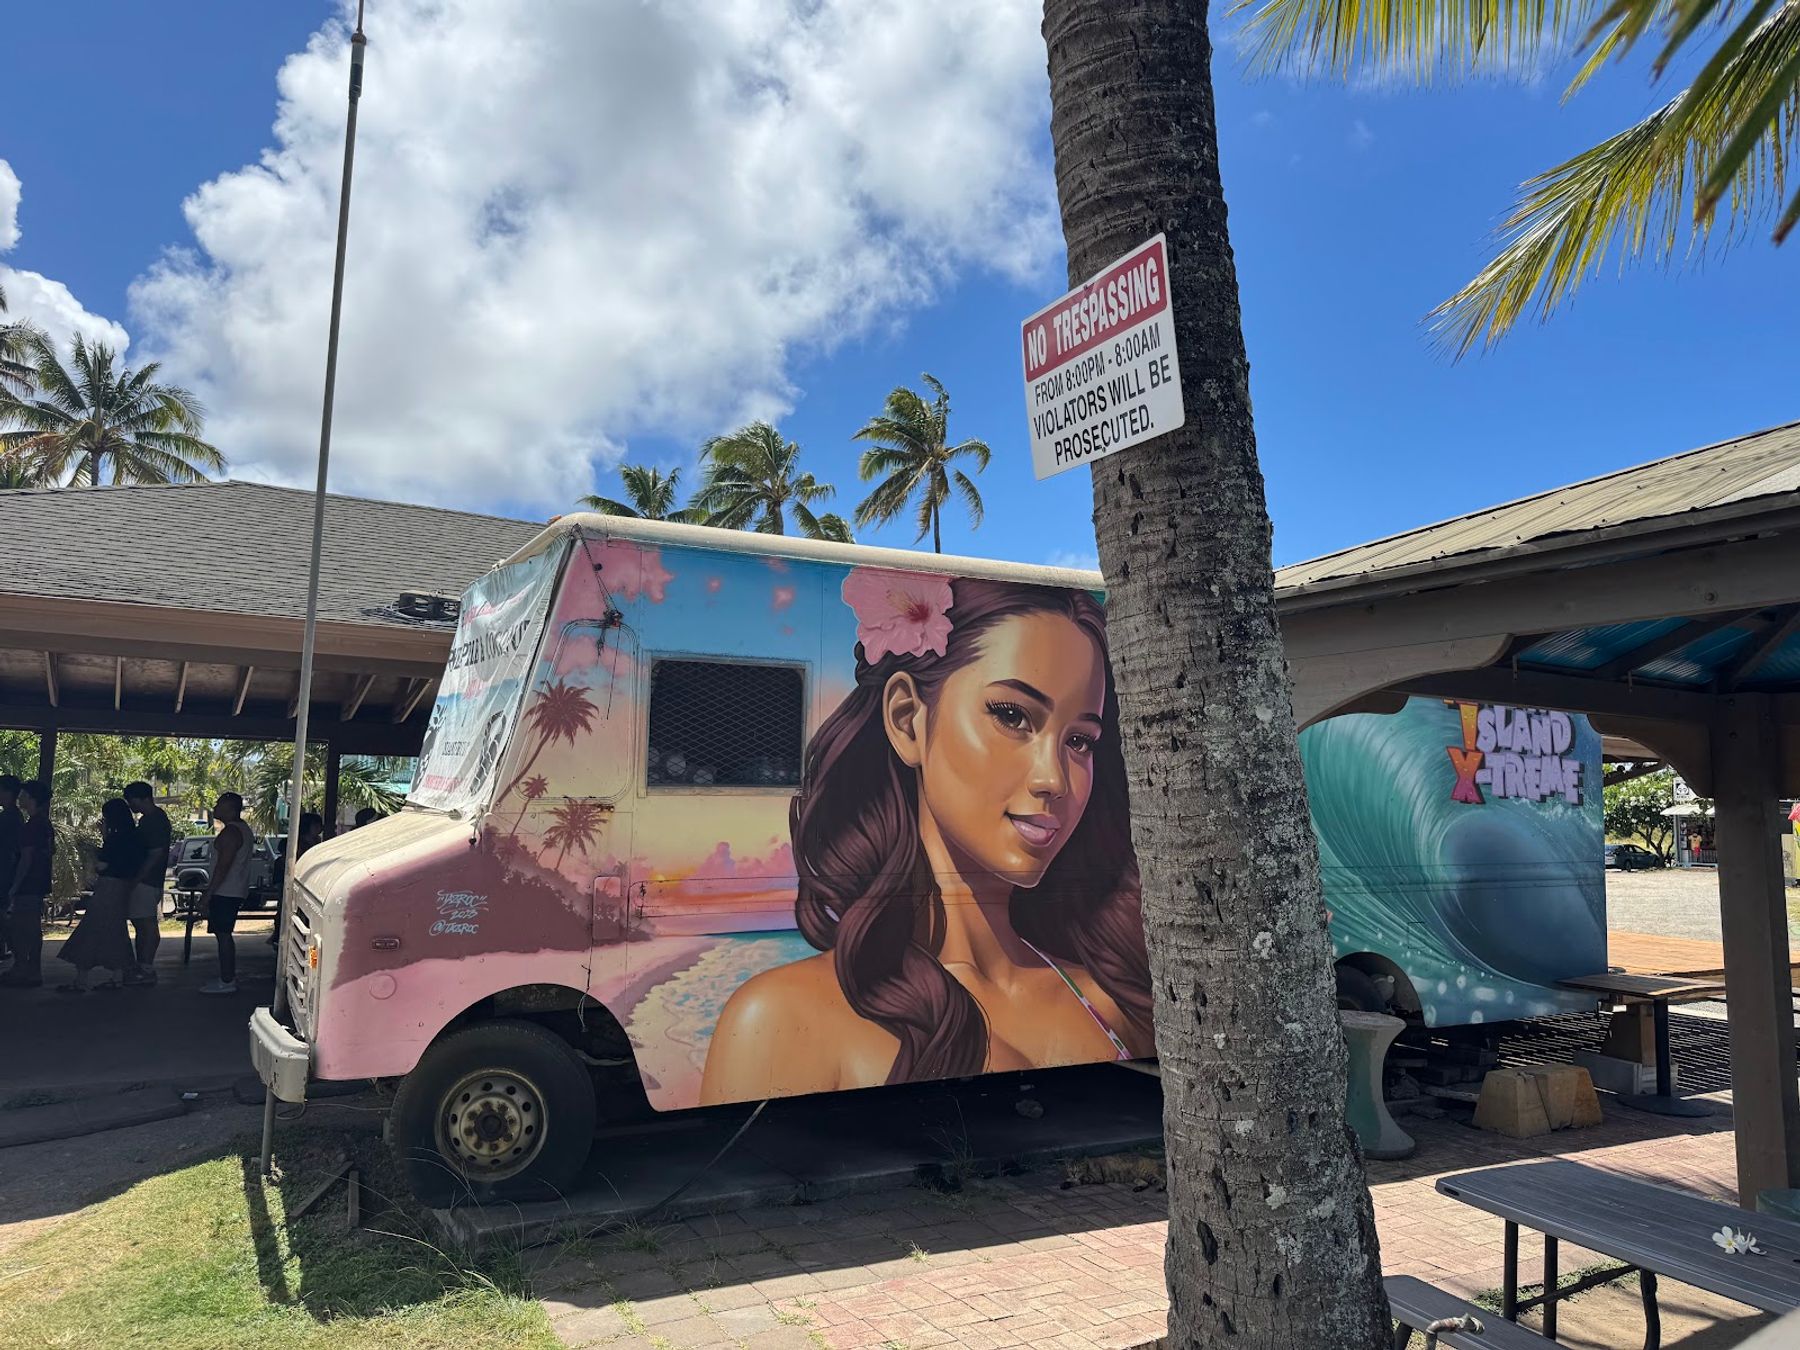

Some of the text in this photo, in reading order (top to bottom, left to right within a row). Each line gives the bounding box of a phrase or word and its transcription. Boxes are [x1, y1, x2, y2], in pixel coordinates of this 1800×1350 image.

[1027, 257, 1161, 371] NO TRESPASSING
[1033, 354, 1172, 440] VIOLATORS WILL BE
[1034, 376, 1064, 407] FROM
[1066, 351, 1106, 396] 8:00PM
[1115, 323, 1161, 367] 8:00AM
[1054, 404, 1154, 466] PROSECUTED.
[1443, 699, 1574, 755] ISLAND
[1446, 746, 1583, 805] X-TREME
